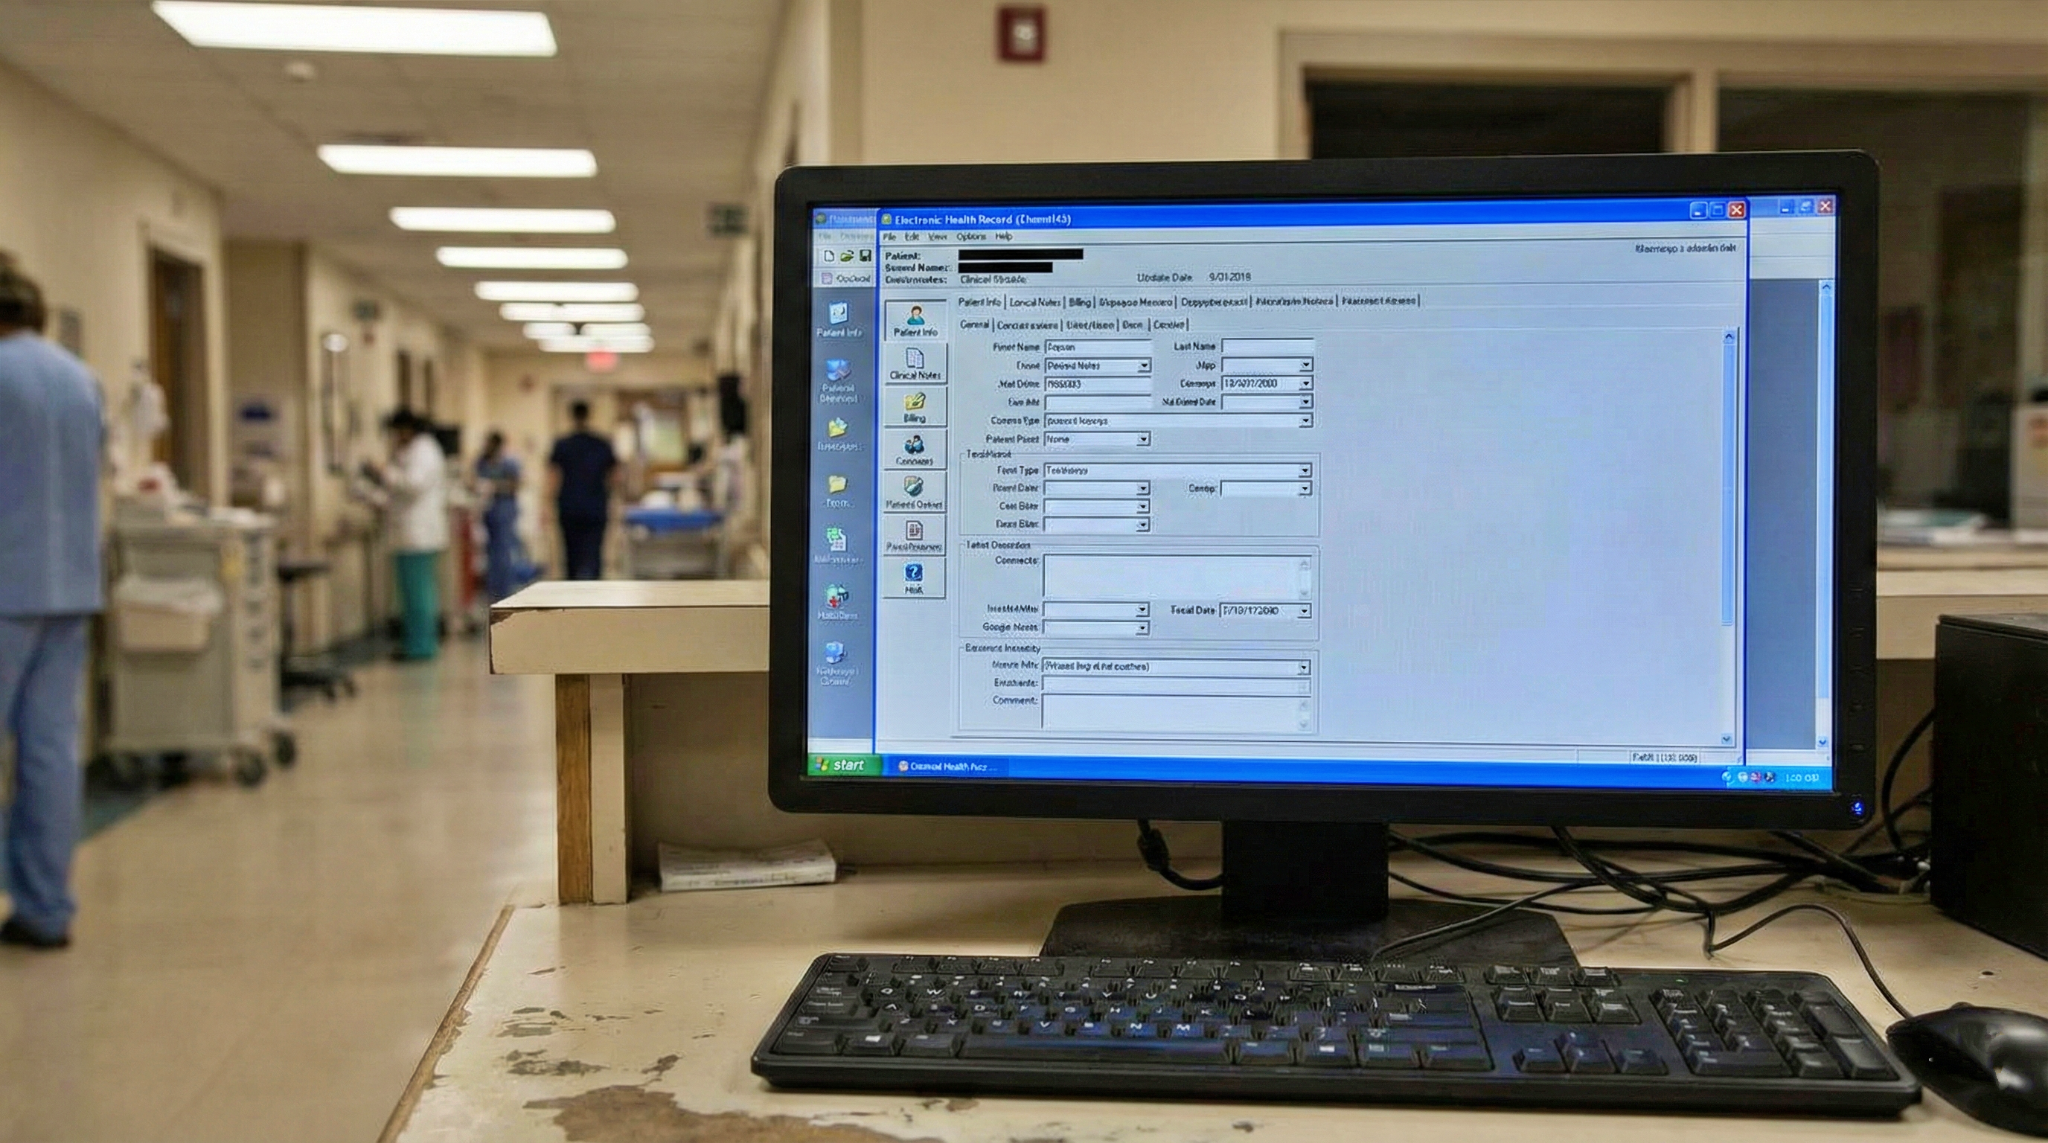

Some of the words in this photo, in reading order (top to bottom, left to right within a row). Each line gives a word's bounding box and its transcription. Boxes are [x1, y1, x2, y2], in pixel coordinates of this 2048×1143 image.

[895, 214, 942, 225] Electronic
[945, 214, 977, 225] Health
[979, 214, 1013, 225] Record
[956, 232, 987, 242] Options
[995, 232, 1013, 242] Help
[922, 328, 938, 337] Info
[1193, 342, 1216, 350] Name
[834, 760, 864, 770] start
